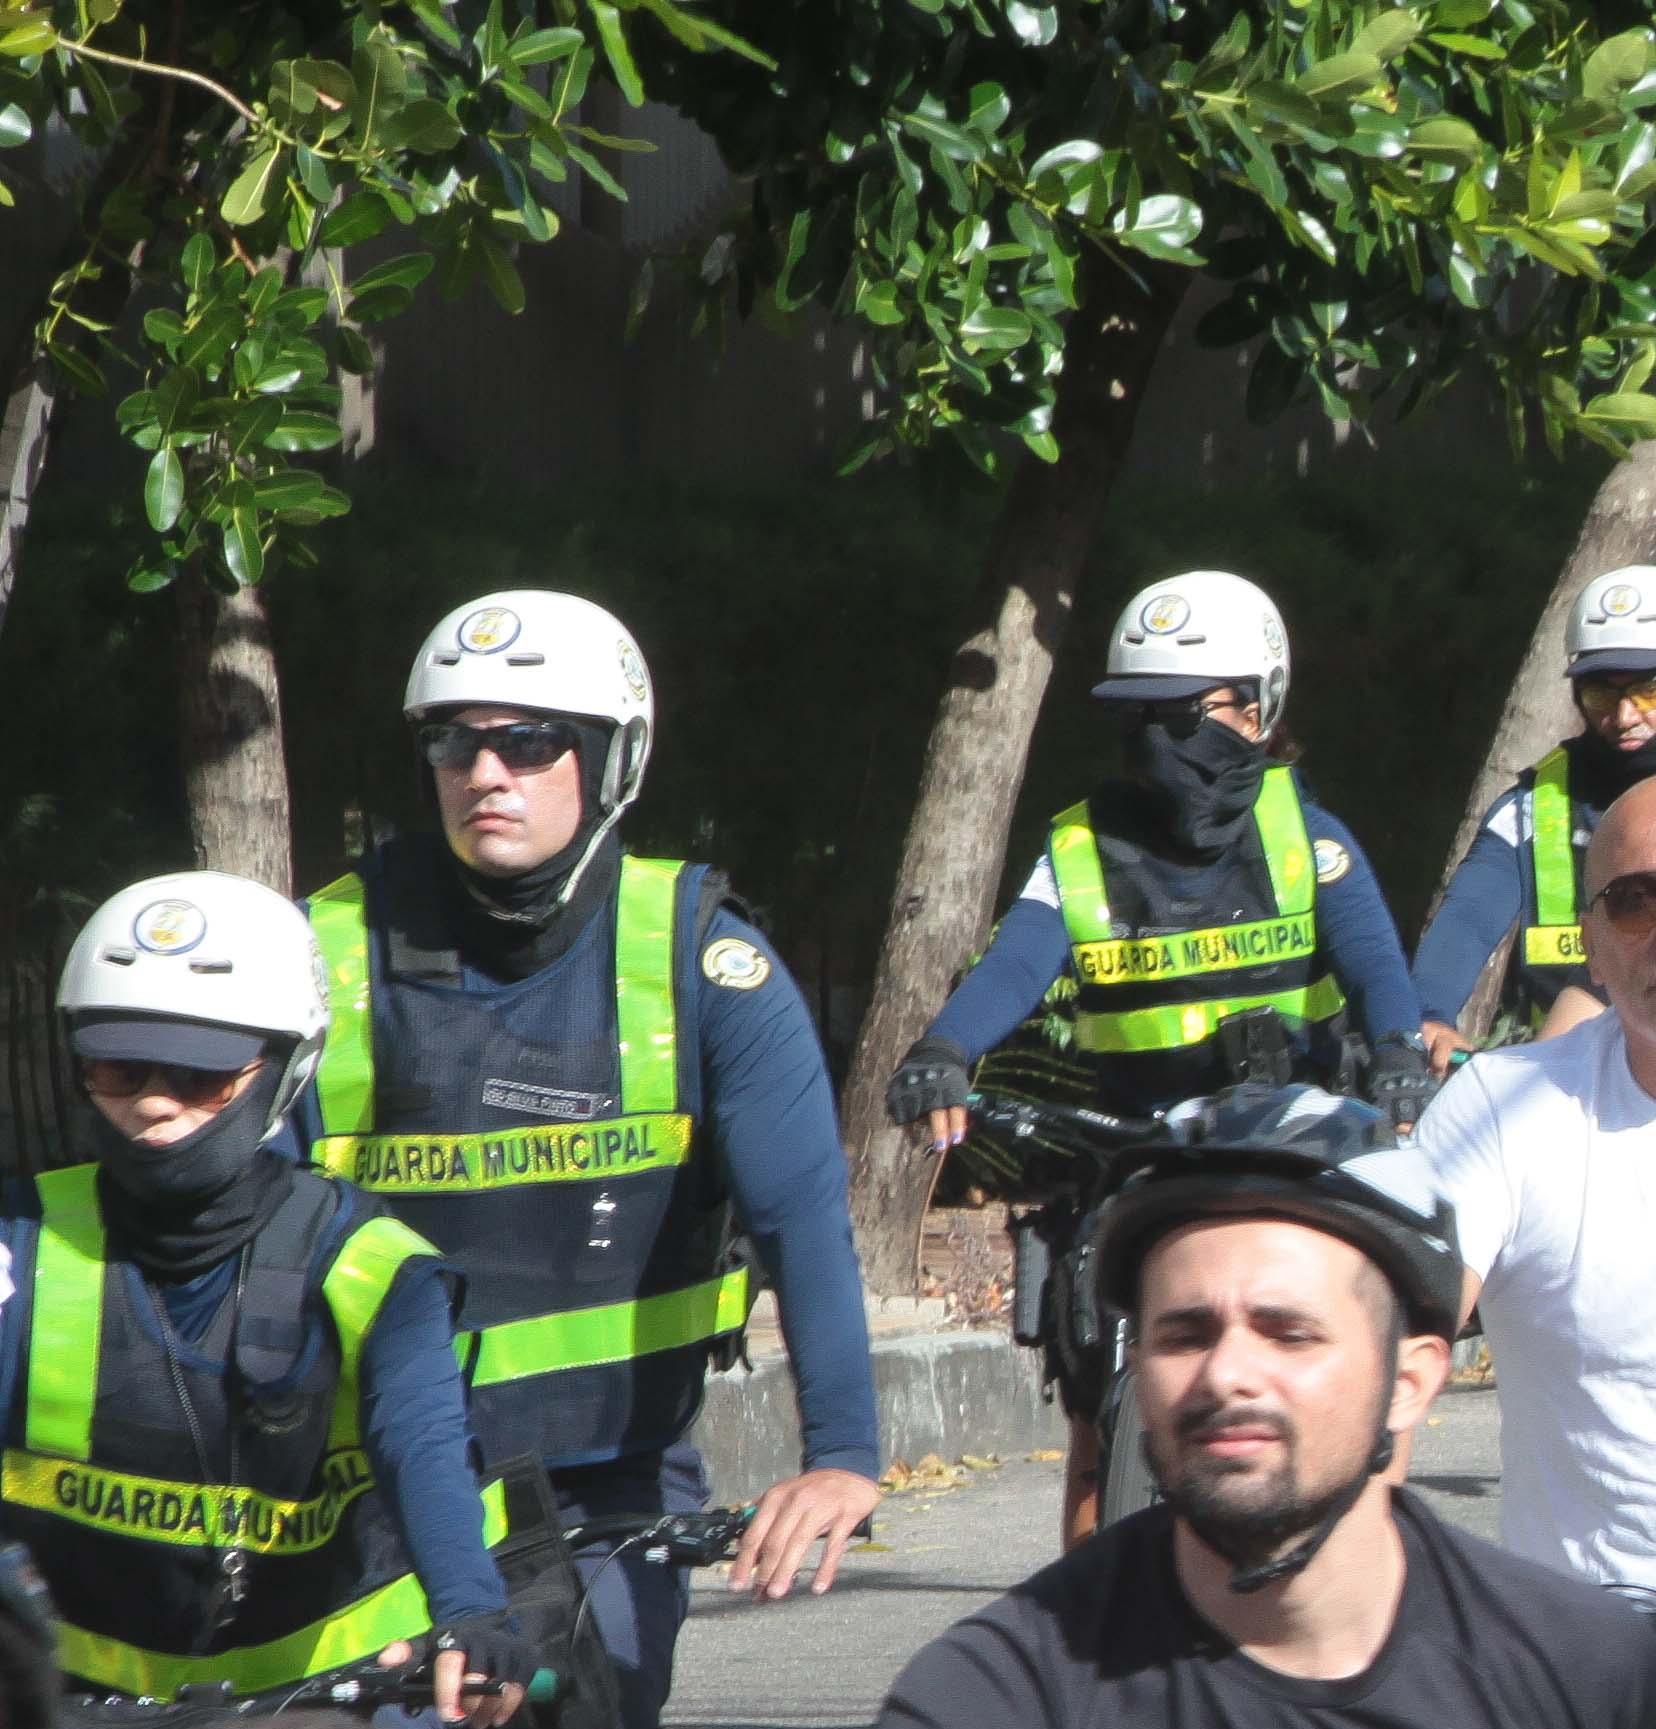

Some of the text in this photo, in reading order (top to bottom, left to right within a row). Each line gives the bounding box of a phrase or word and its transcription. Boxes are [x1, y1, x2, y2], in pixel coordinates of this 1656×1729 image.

[1079, 917, 1314, 978] GUARDA MUNICIPAL
[354, 1123, 657, 1184] GUARDA MUNICIPAL
[54, 1469, 207, 1534] GUARDA
